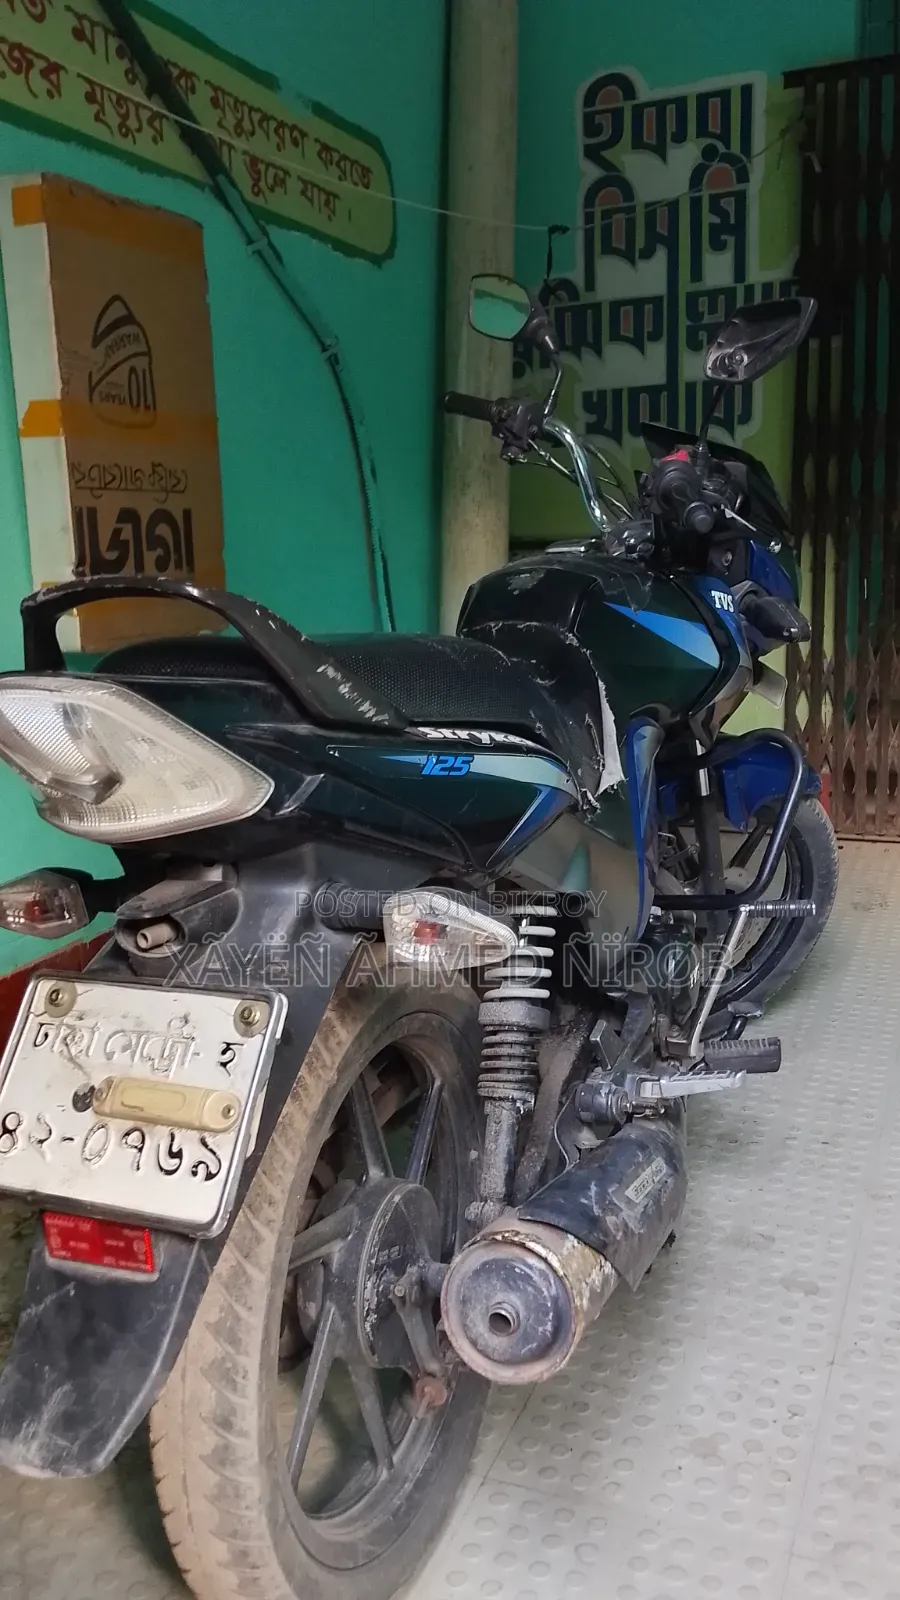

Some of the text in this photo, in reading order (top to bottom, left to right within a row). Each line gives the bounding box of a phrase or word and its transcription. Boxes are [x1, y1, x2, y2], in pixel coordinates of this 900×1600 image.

[64, 5, 200, 99] মানুক
[204, 79, 308, 158] মৃত্যুবরণ
[313, 137, 373, 190] করতে
[76, 71, 169, 145] মৃত্যুর
[242, 150, 292, 204] ভুলে
[127, 364, 151, 412] 10
[710, 589, 735, 613] TVS
[421, 754, 475, 776] 125
[33, 1018, 102, 1058] ঢাকা
[217, 1040, 245, 1078] হ
